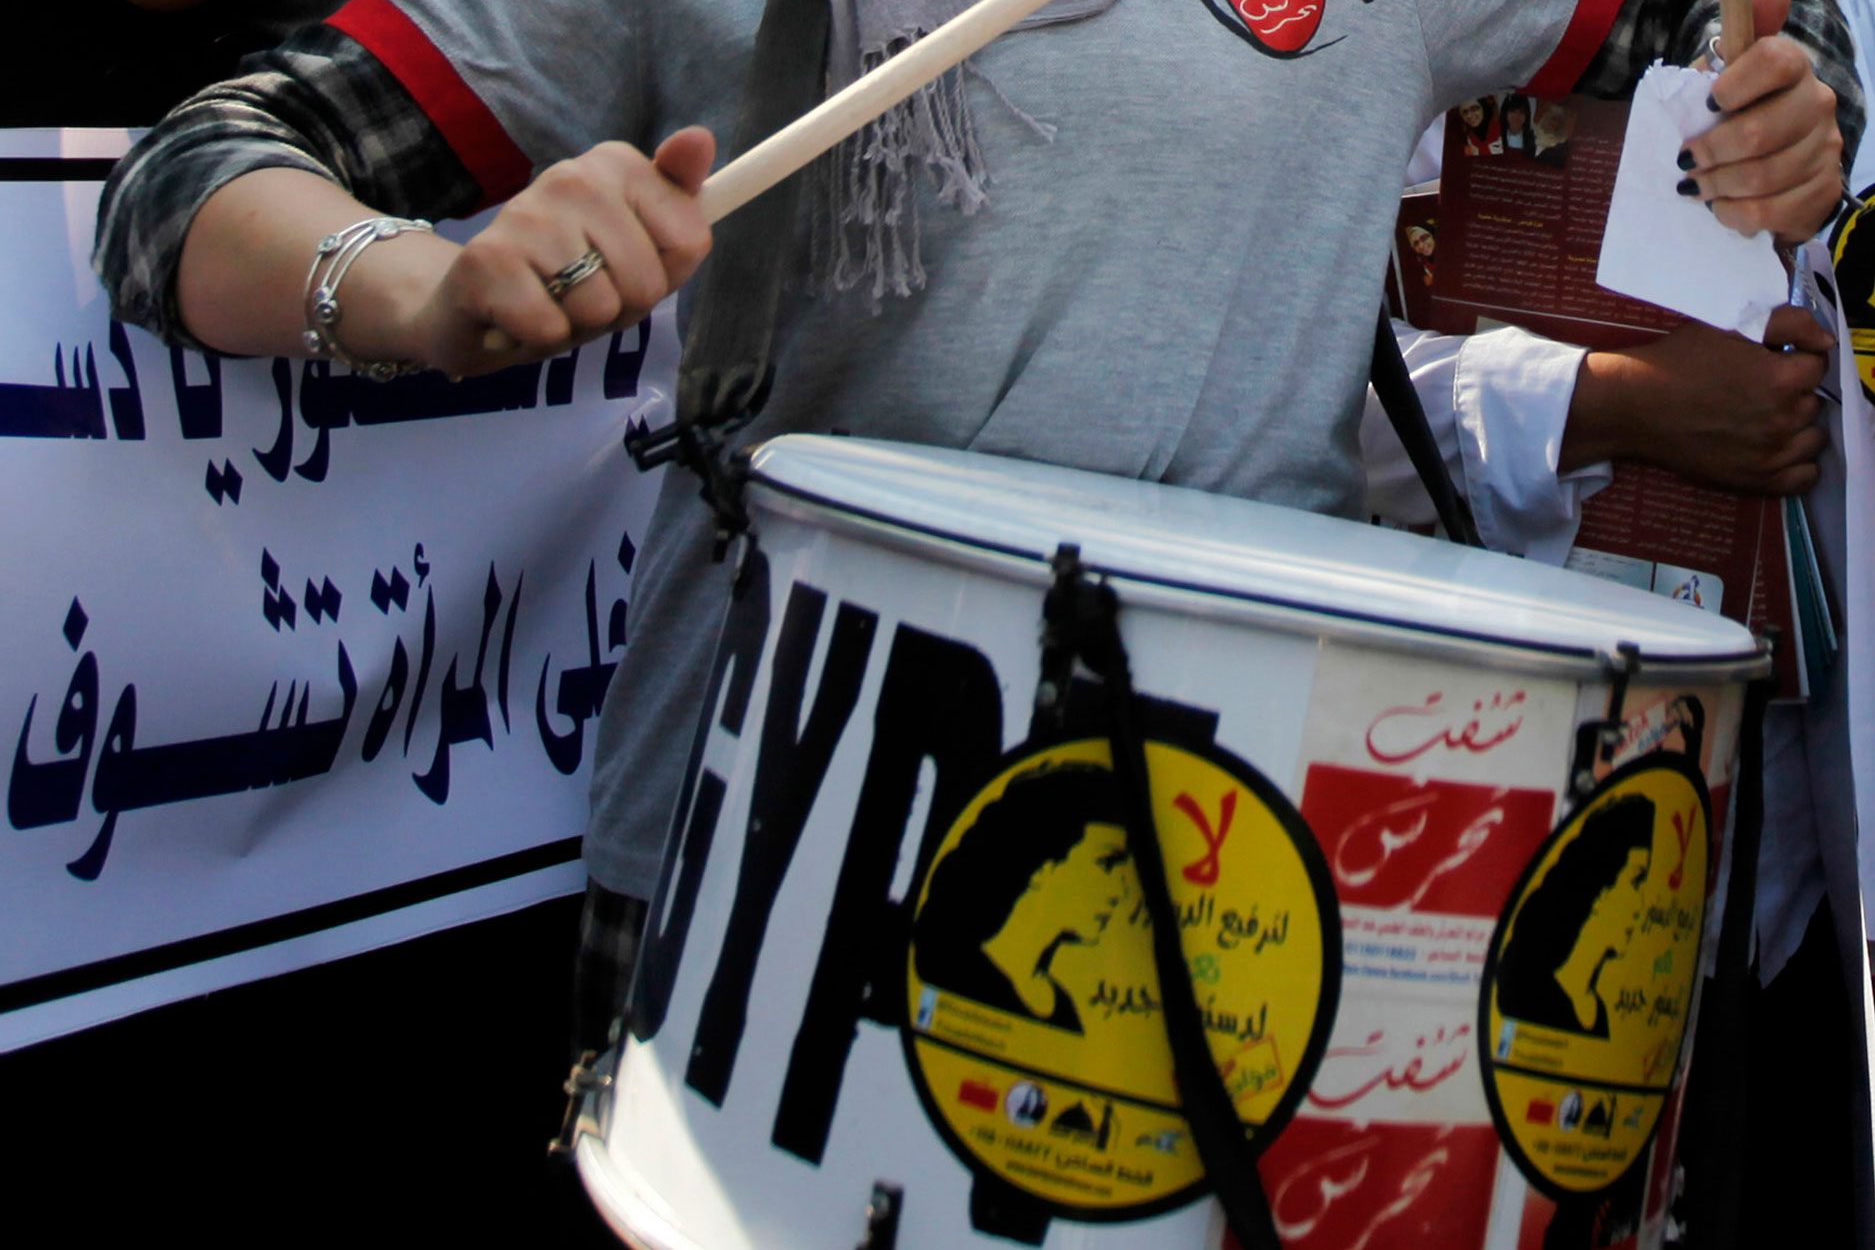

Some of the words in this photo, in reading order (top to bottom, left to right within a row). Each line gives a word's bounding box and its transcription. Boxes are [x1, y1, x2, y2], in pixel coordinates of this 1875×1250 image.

[7, 546, 358, 882] تشوف
[361, 543, 524, 805] المرأة
[1172, 788, 1239, 887] لا
